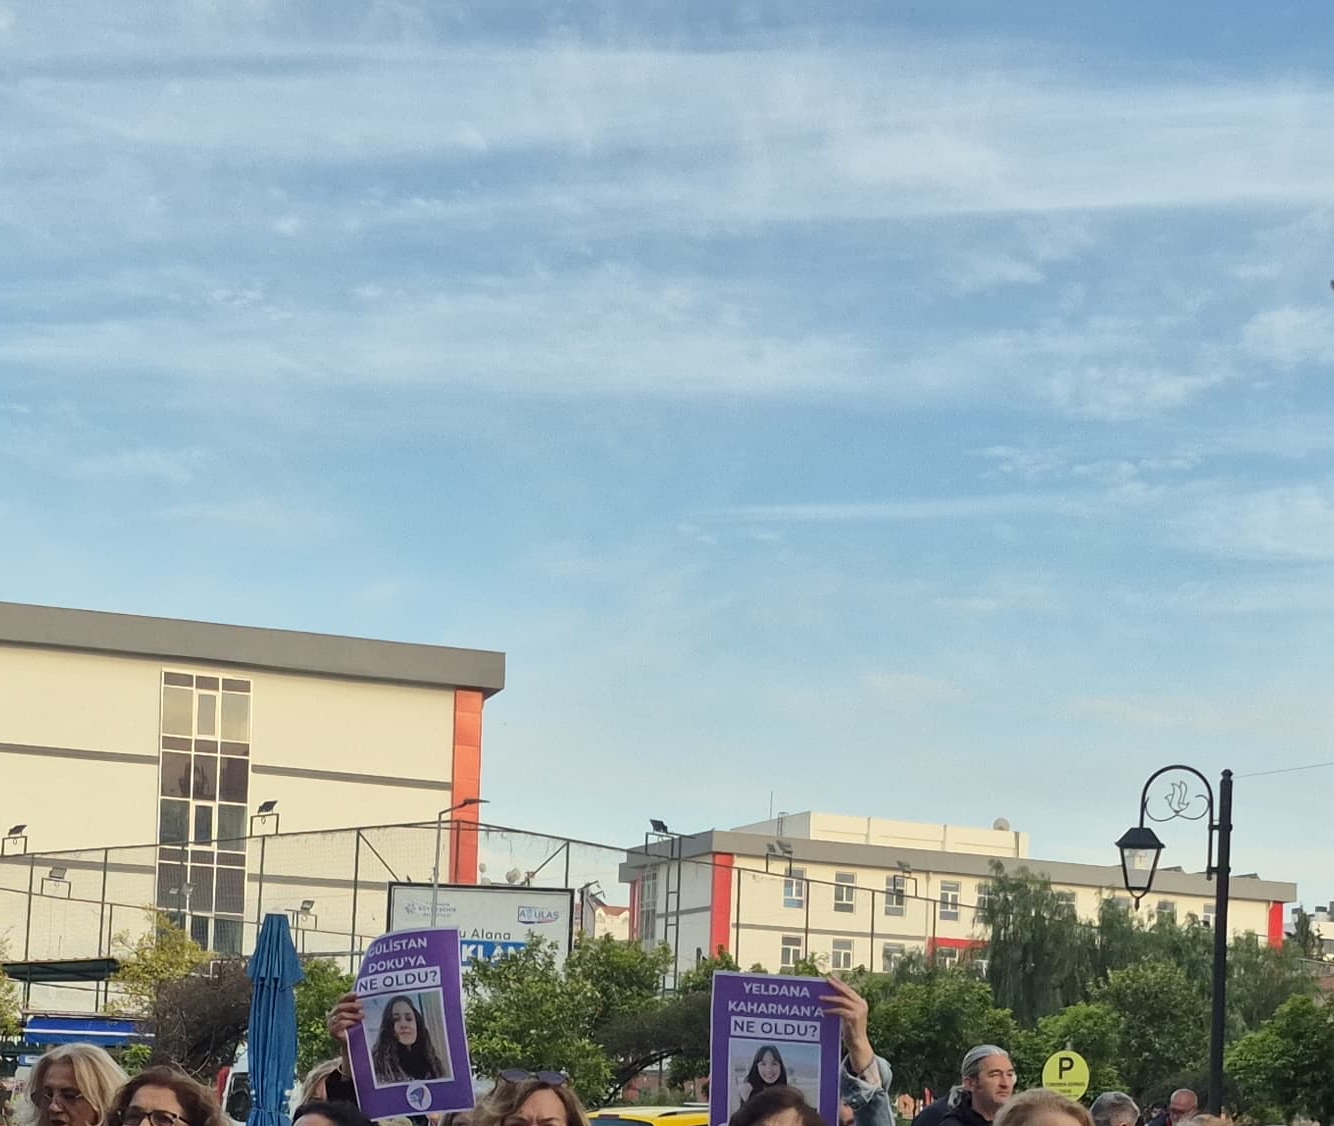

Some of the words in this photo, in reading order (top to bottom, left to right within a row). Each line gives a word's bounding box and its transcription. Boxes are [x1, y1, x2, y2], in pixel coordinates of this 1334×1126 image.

[471, 928, 511, 940] Alana
[368, 936, 428, 959] GÜLİSTAN
[368, 954, 427, 974] DOKU'YA
[358, 978, 377, 993] NE
[382, 970, 437, 987] OLDU?
[743, 982, 811, 998] YELDANA
[728, 1000, 825, 1018] KAHARMAN'A
[733, 1019, 755, 1033] NE
[761, 1022, 817, 1037] OLDU?
[1059, 1057, 1074, 1079] P
